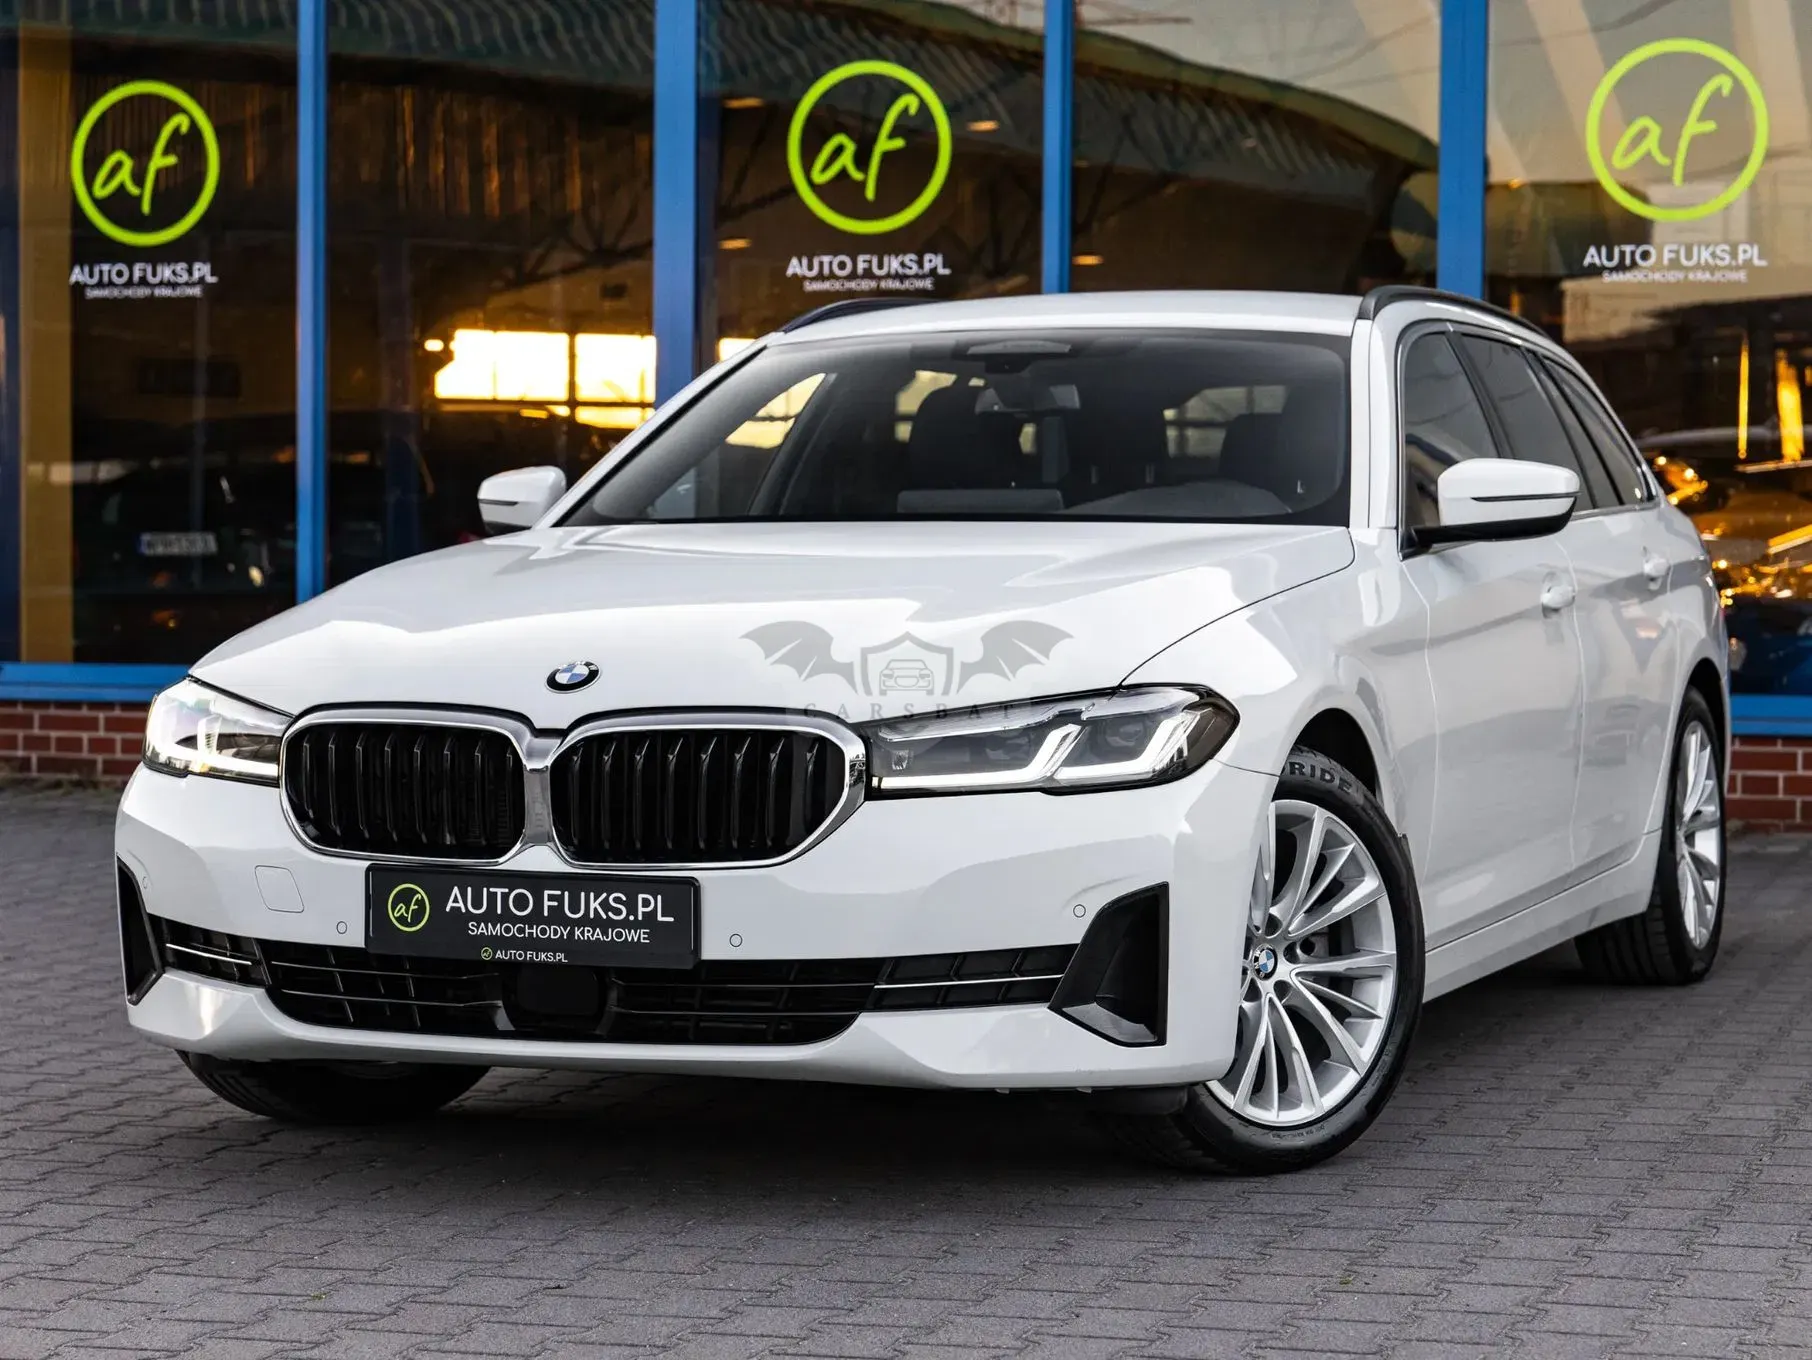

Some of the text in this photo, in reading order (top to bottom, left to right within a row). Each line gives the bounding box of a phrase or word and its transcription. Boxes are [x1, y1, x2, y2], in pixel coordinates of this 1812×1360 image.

[1611, 73, 1734, 188] af
[811, 92, 921, 203] af
[92, 112, 192, 217] af
[785, 252, 952, 278] AUTO FUKS.PL
[1582, 243, 1769, 269] AUTO FUKS.PL
[68, 260, 219, 286] AUTO FUKS.PL
[445, 885, 675, 923] AUTO FUKS.PL
[467, 921, 651, 944] SAMOCHODY KRAJOWE
[494, 949, 569, 963] AUTO FUKS.PL
